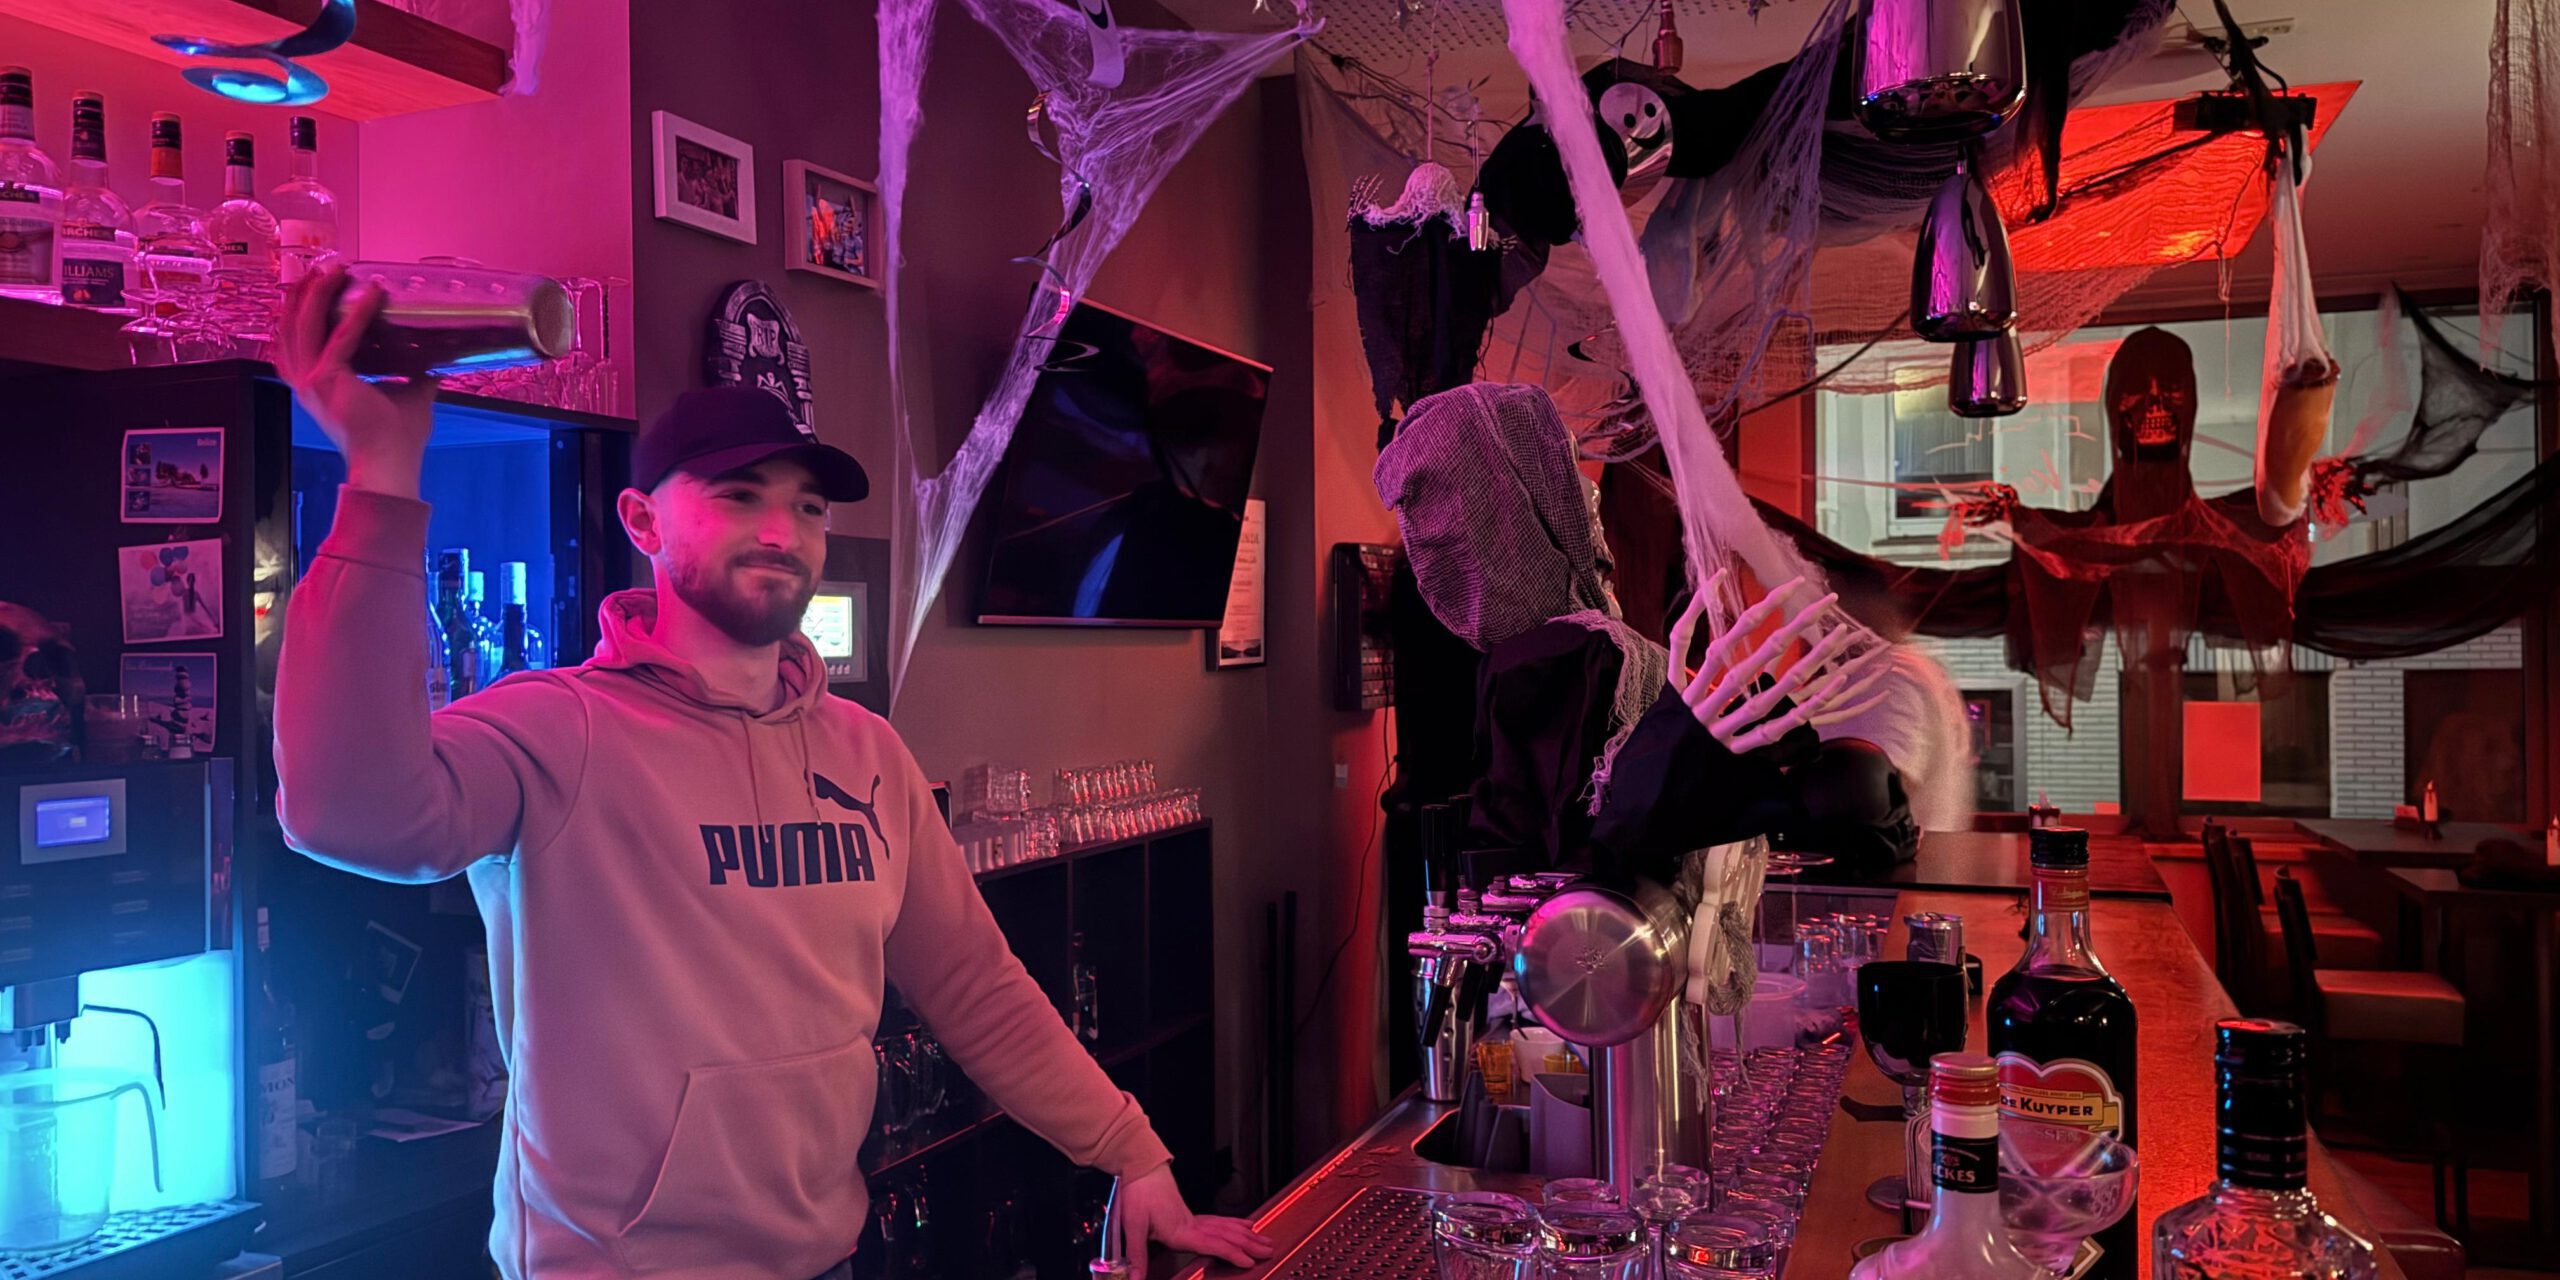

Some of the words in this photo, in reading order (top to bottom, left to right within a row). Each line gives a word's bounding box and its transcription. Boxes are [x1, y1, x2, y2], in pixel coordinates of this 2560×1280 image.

[62, 226, 112, 238] IRCHER
[64, 264, 115, 279] ILLIAMS
[756, 327, 777, 346] RIP
[699, 822, 876, 888] PUMA
[2020, 1097, 2094, 1116] KUYPER
[1933, 1163, 1976, 1183] ECKES
